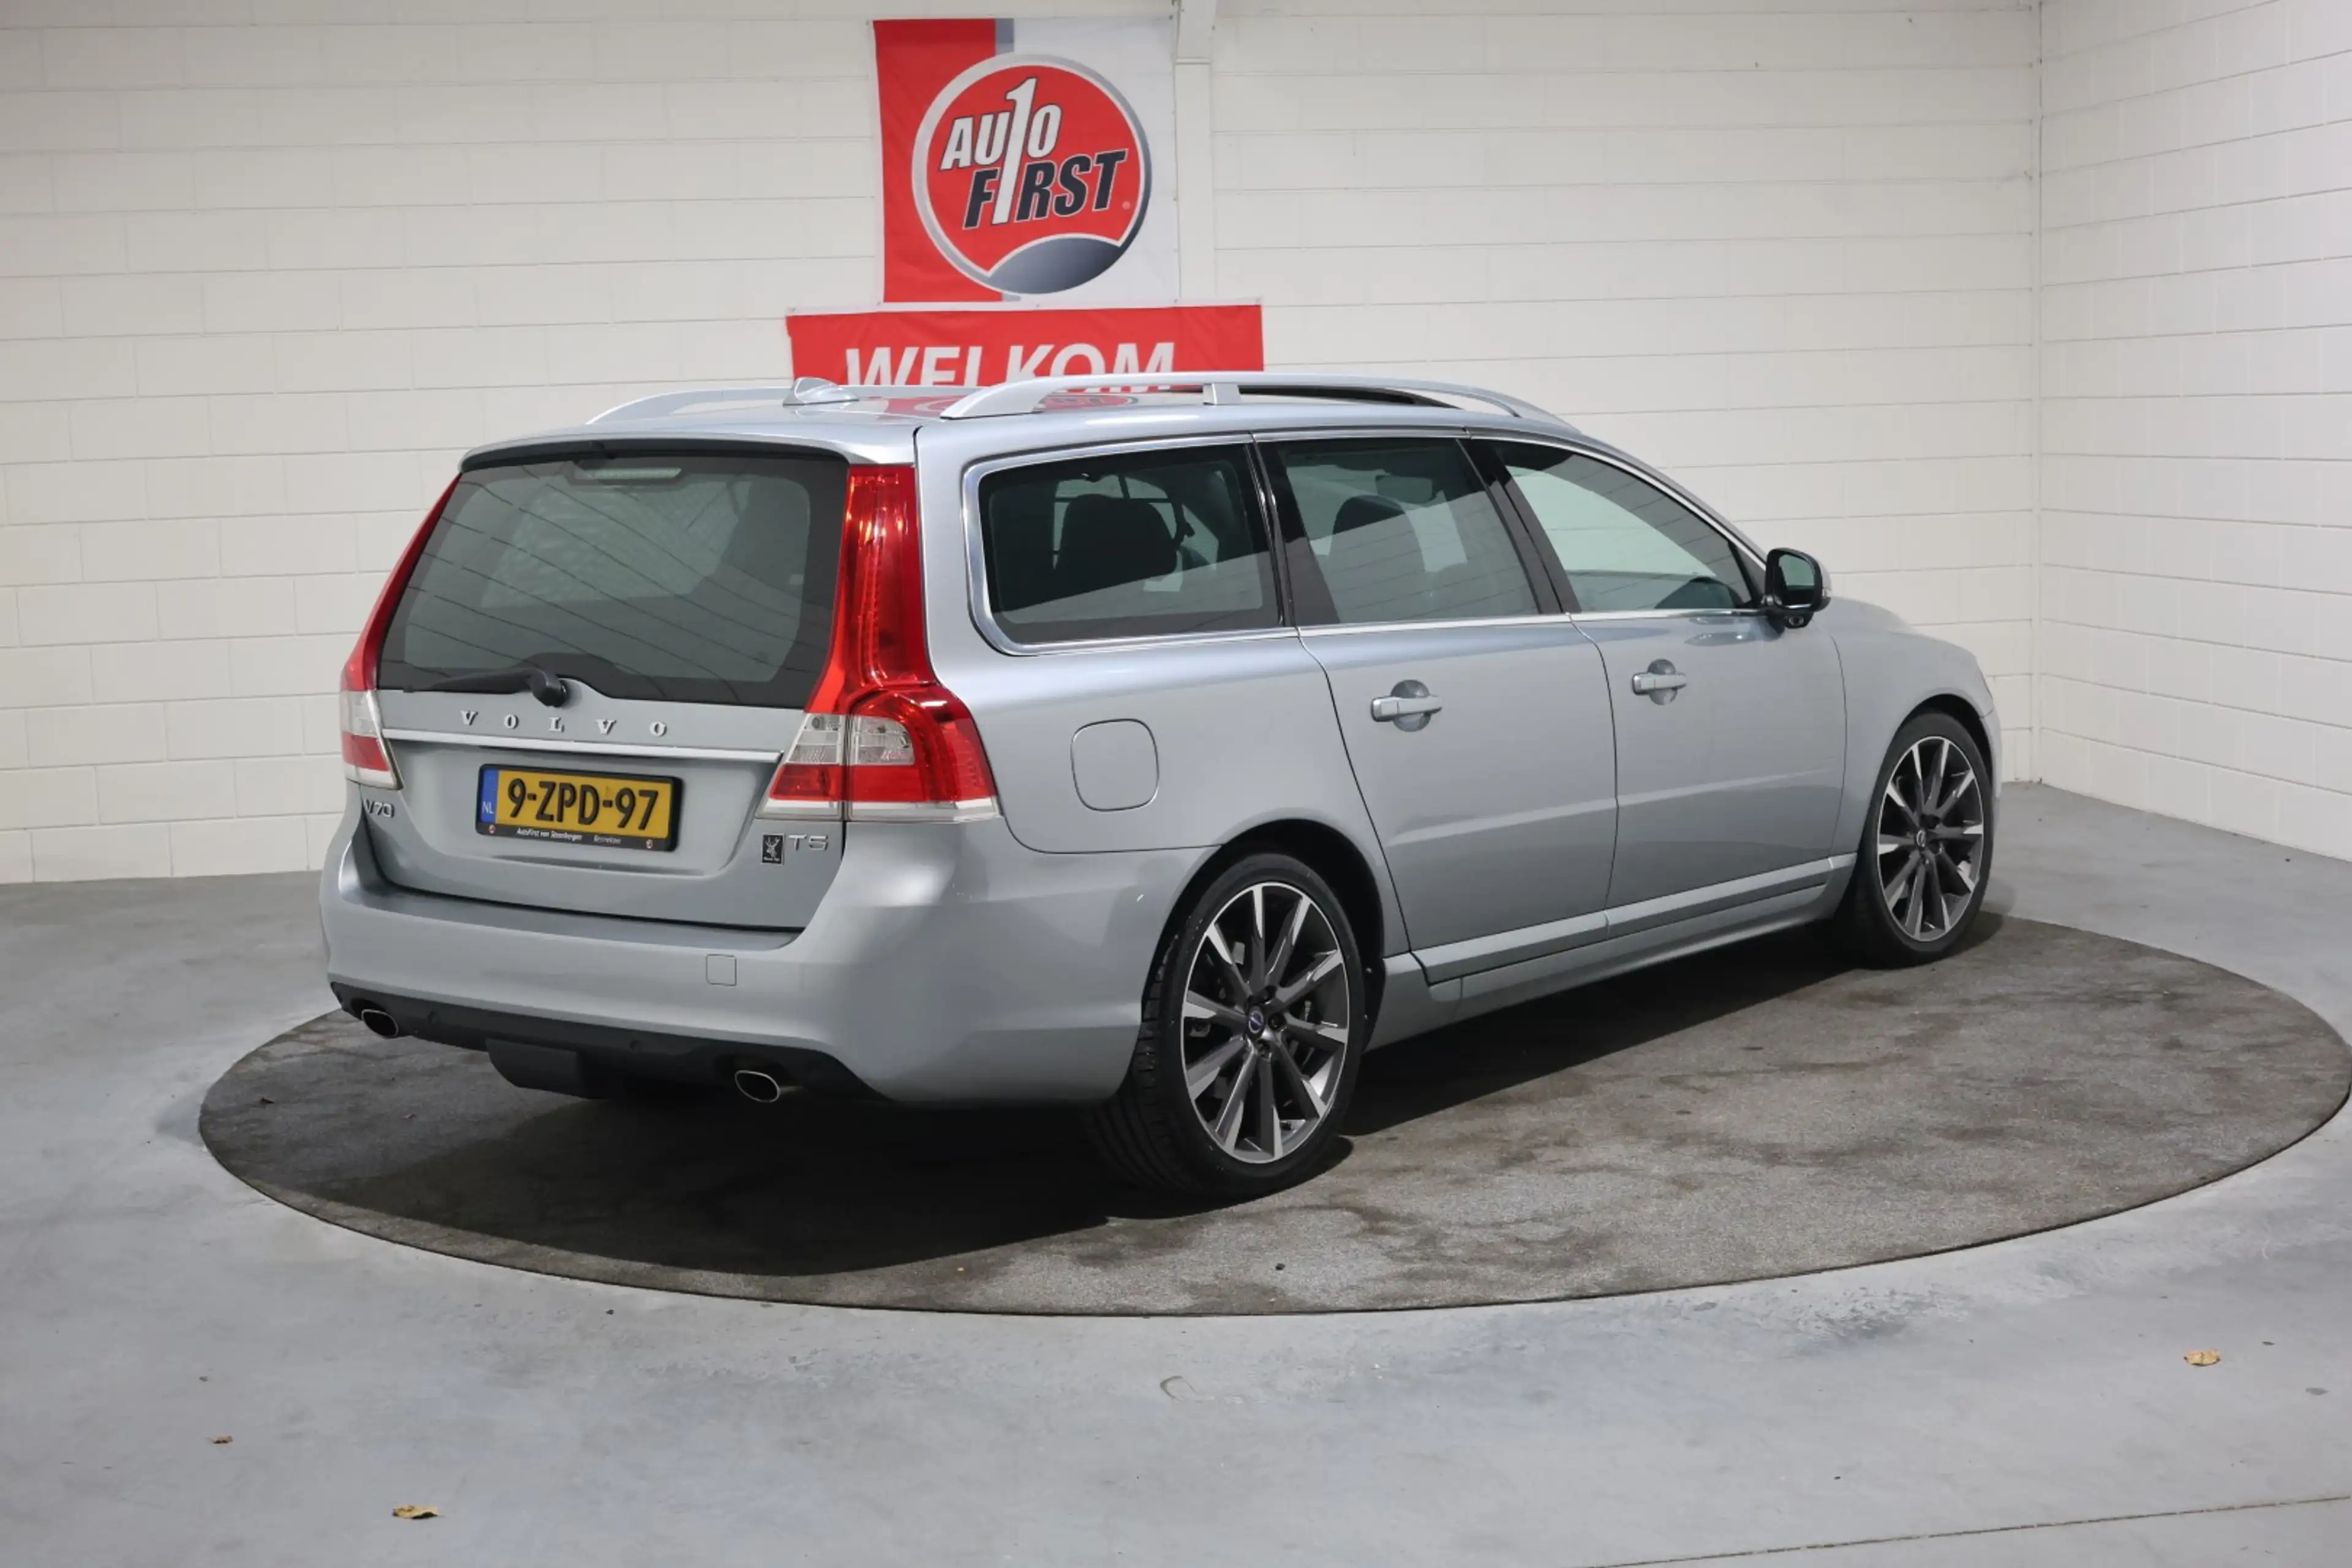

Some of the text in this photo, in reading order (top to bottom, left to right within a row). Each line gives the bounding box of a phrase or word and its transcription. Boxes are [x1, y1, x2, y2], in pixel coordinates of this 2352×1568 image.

[461, 709, 668, 736] VOLVO
[363, 798, 395, 818] V70
[482, 801, 494, 814] NL
[508, 778, 658, 831] 9-ZPD-97
[788, 834, 828, 851] T5
